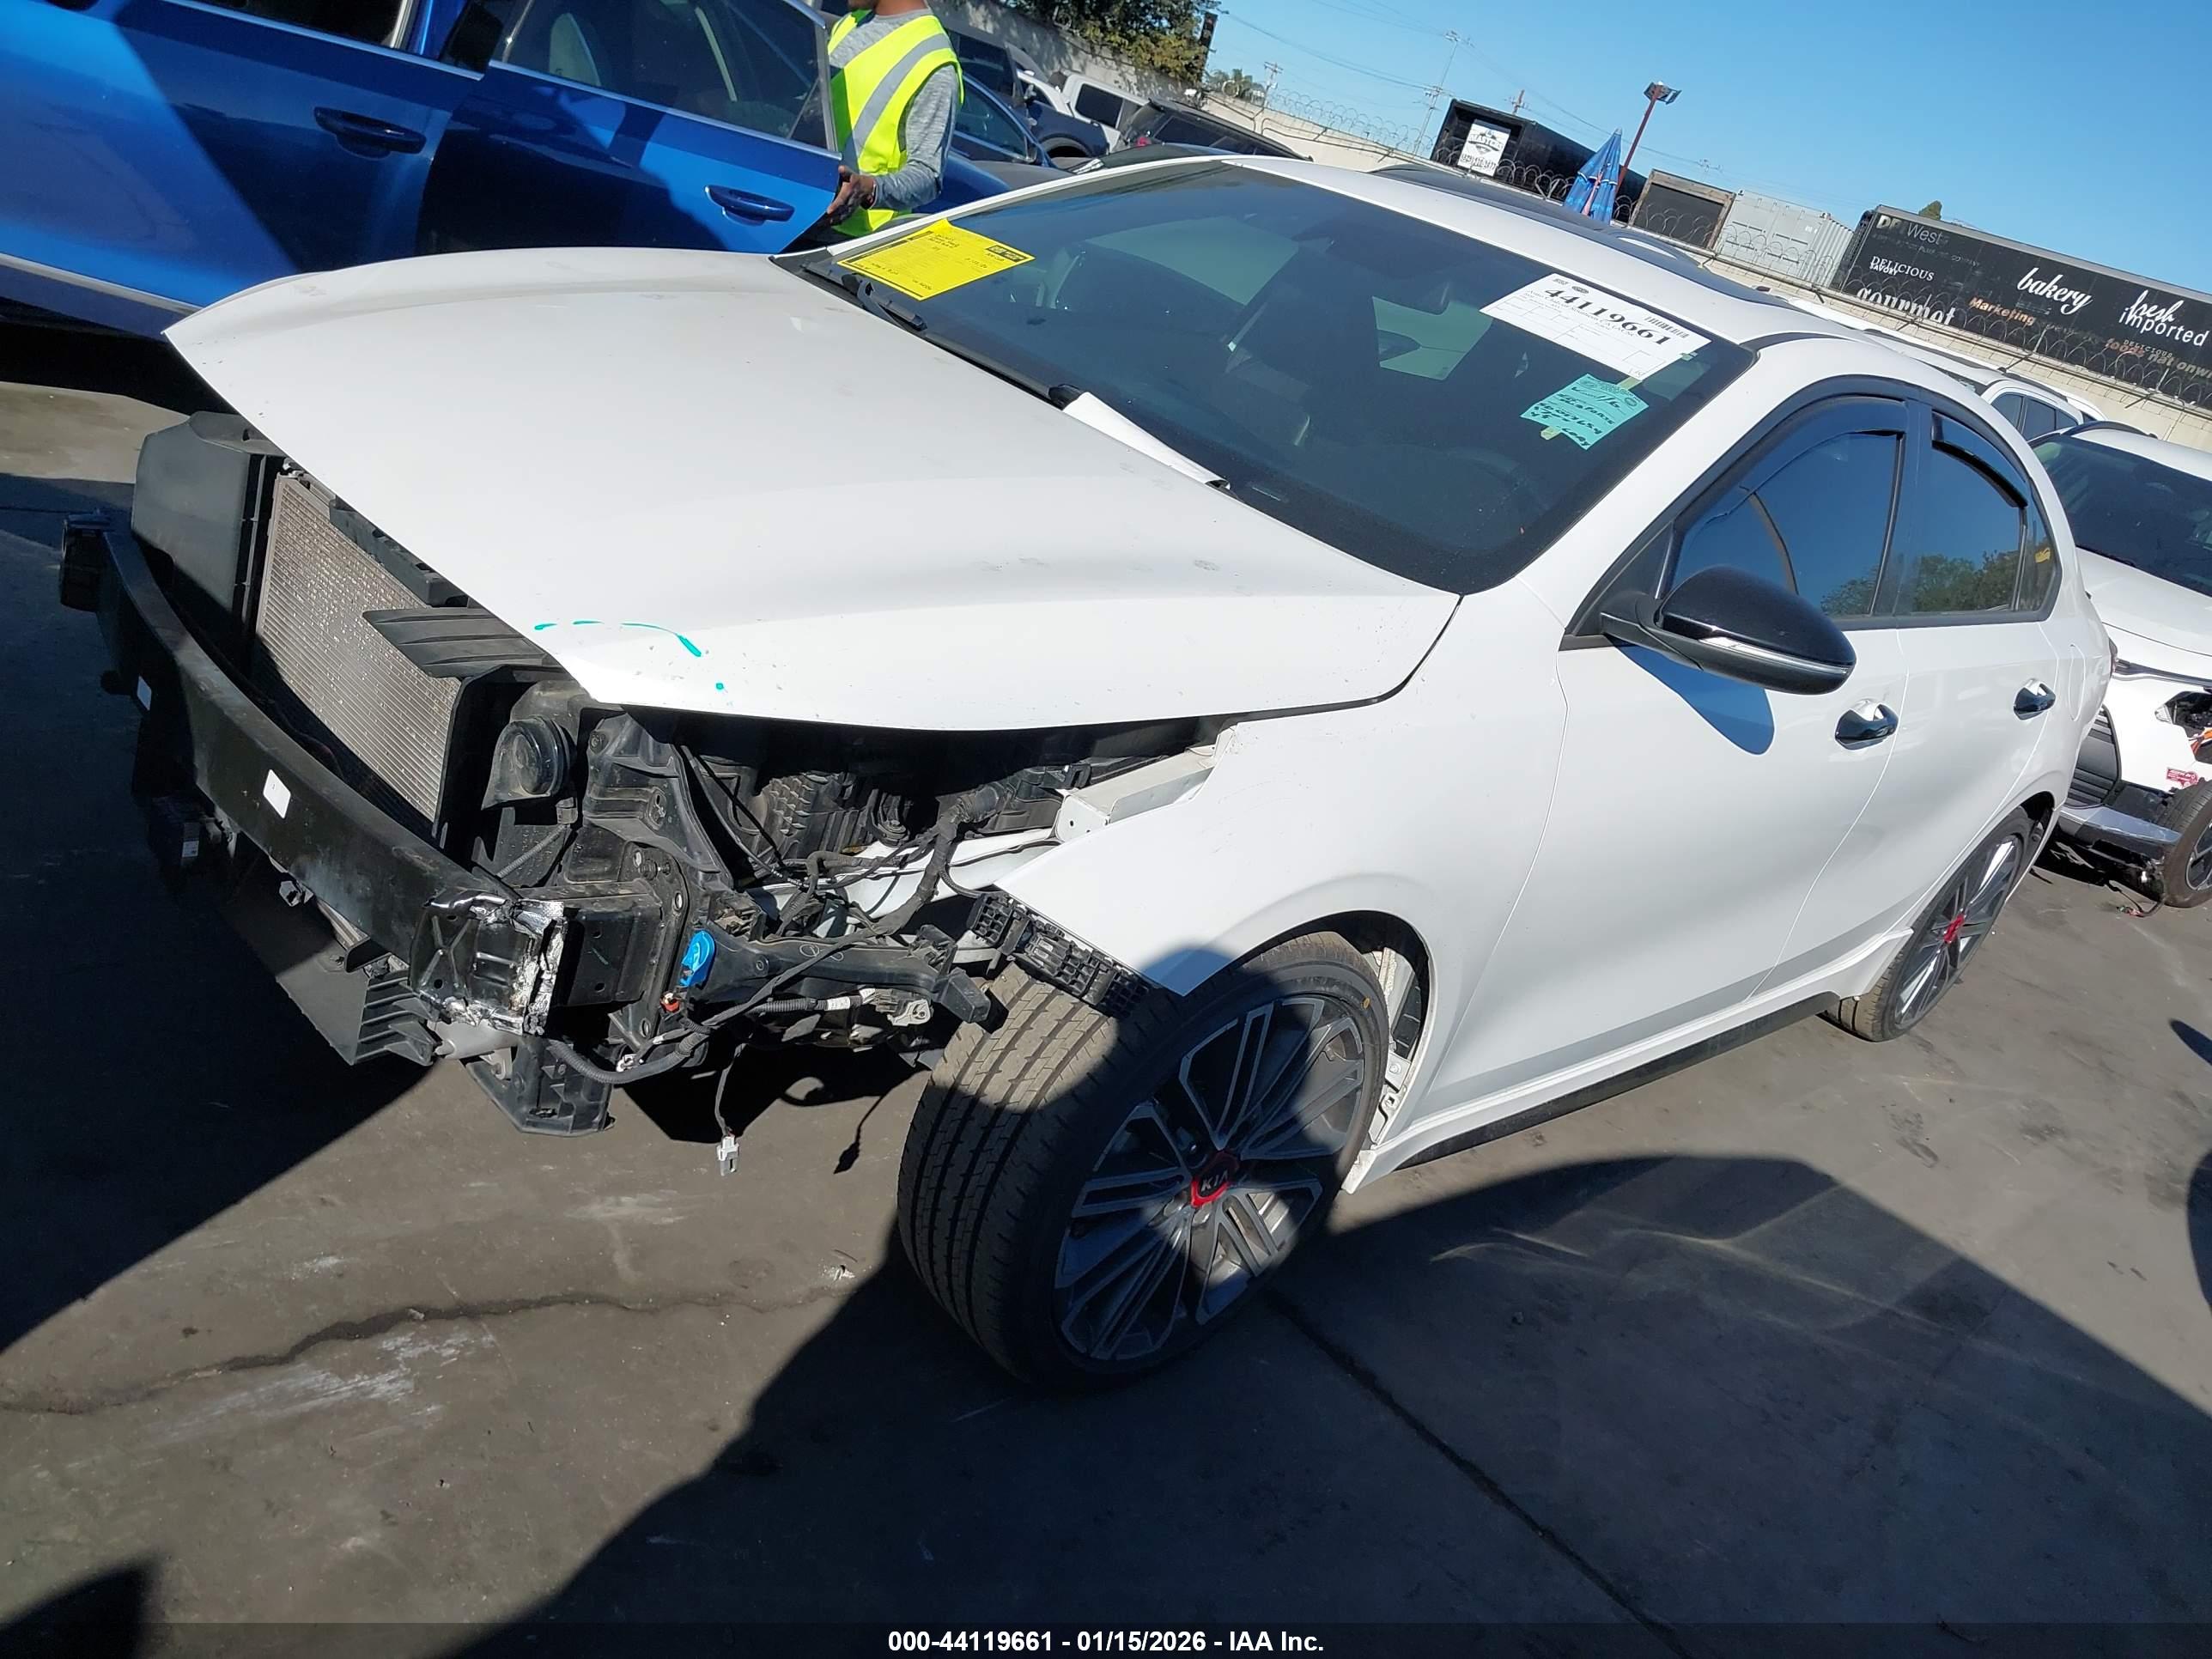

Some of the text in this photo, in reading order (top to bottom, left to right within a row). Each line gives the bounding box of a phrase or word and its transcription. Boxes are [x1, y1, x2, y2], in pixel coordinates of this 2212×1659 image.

[1869, 261, 1898, 276] SAVORY
[1872, 255, 1935, 282] DELICIOUS
[2017, 267, 2094, 315] bakery
[2127, 289, 2185, 323] fresh
[1544, 288, 1671, 345] 44119661
[1969, 297, 2036, 326] Marketing
[2118, 307, 2209, 347] imported
[1201, 1170, 1228, 1192] KIA
